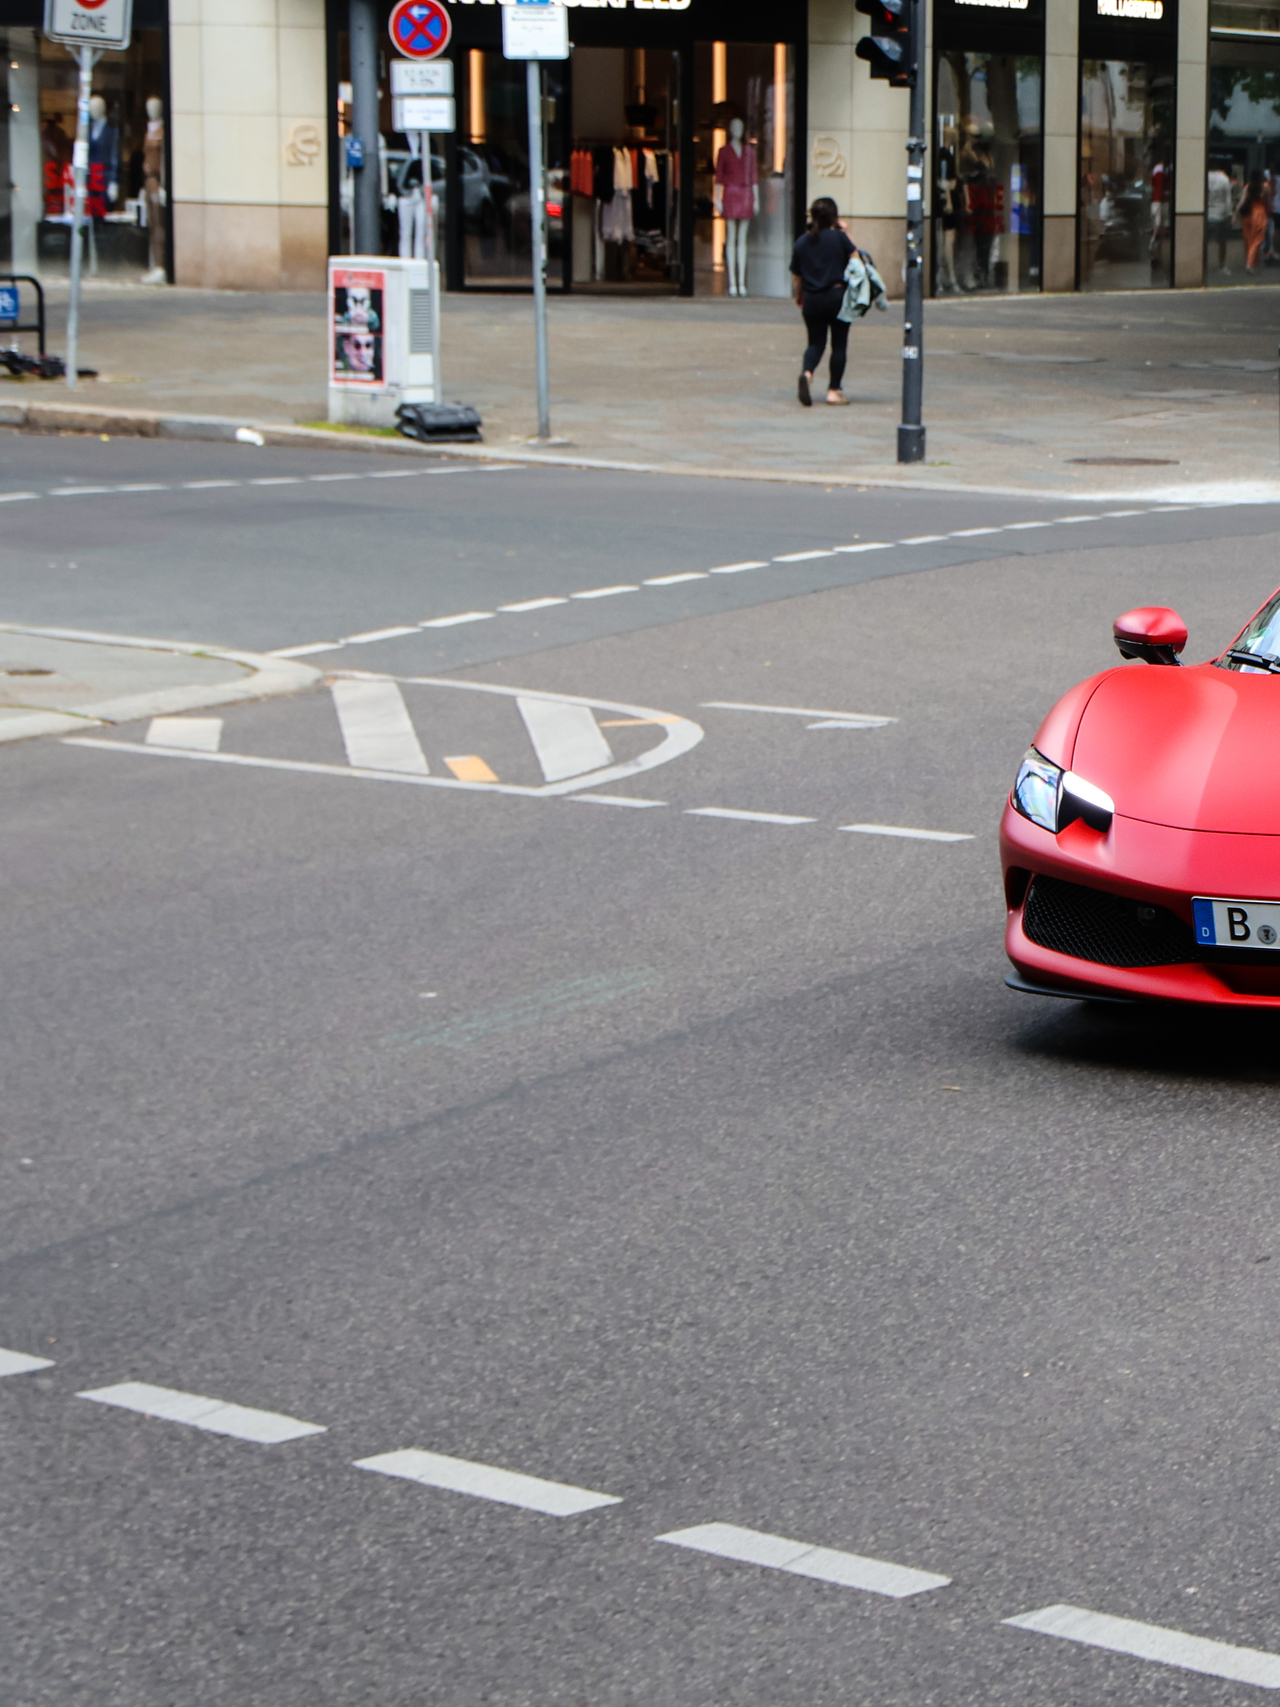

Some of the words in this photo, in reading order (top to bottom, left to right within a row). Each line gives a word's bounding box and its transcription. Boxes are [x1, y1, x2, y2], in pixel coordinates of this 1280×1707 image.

[71, 12, 106, 33] ZONE
[45, 161, 106, 192] SAE
[1201, 927, 1210, 938] D
[1227, 907, 1251, 942] B
